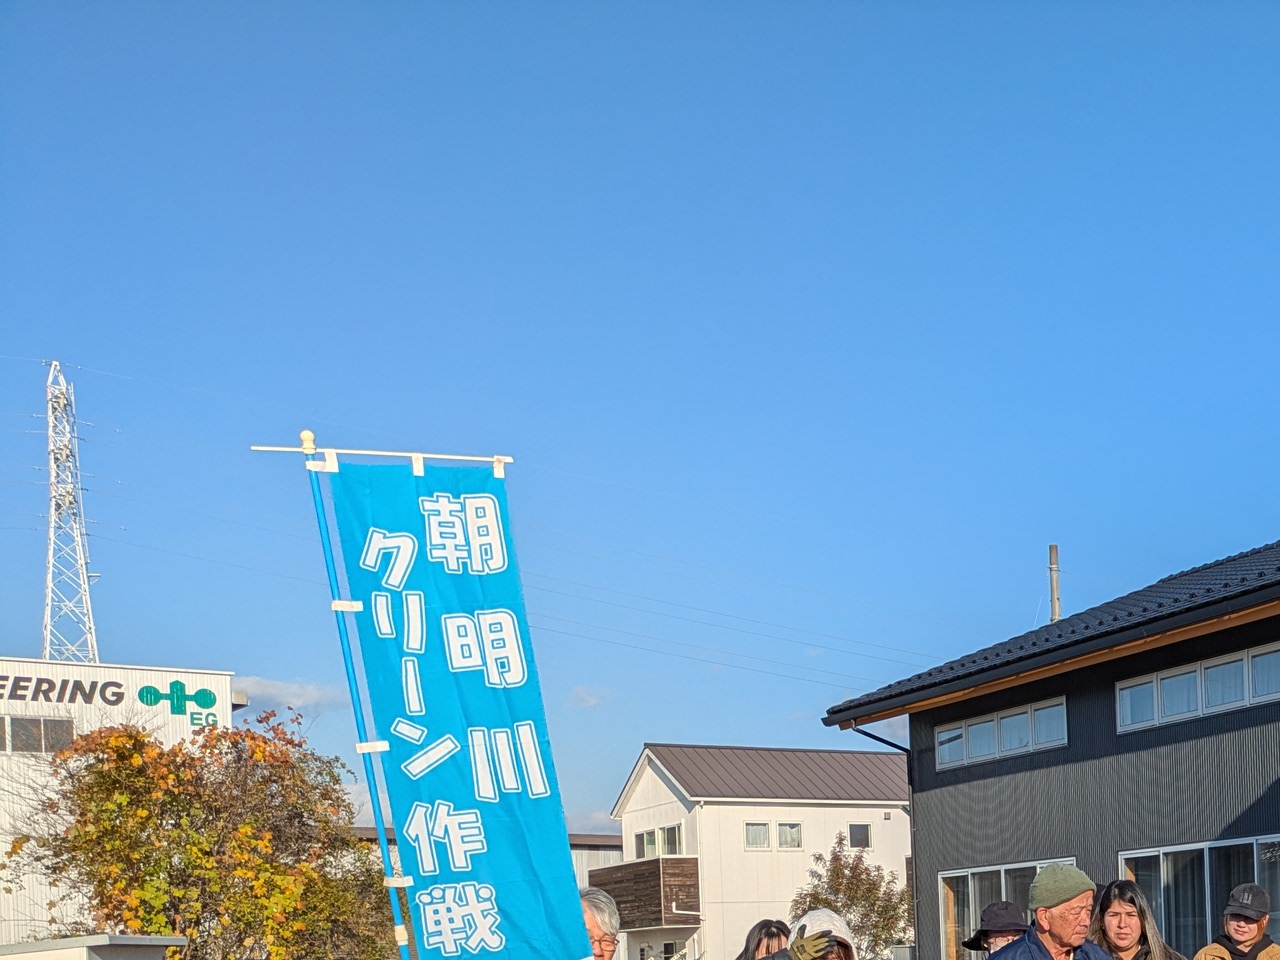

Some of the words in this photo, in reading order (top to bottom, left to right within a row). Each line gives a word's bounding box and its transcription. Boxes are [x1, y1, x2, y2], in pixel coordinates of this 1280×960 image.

[190, 711, 218, 726] EG
[359, 527, 507, 957] クリーン作戦
[418, 492, 551, 803] 朝明川
